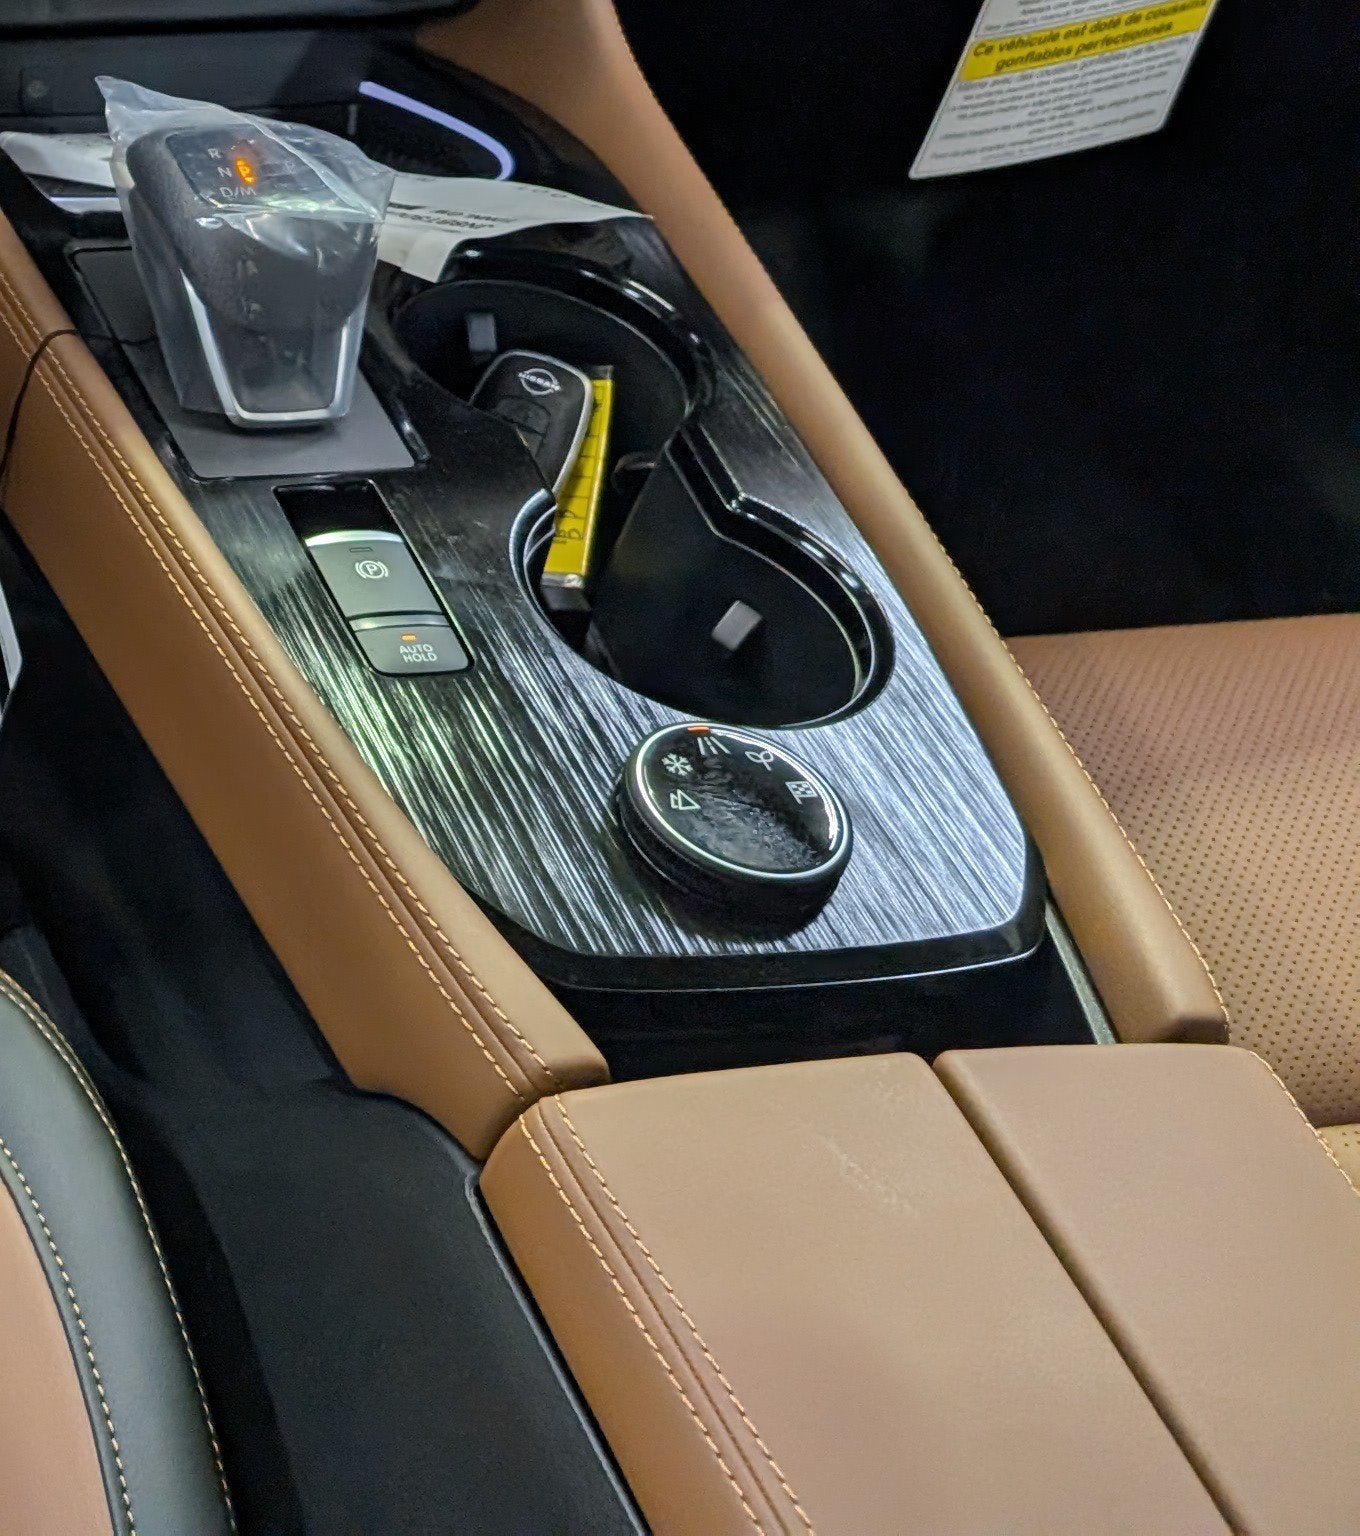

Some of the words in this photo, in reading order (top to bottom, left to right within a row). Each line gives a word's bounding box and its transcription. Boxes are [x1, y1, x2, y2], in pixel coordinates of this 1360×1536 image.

[972, 42, 994, 58] Ce
[207, 147, 222, 160] R
[217, 166, 233, 178] N
[219, 186, 257, 200] D/M
[399, 643, 434, 654] AUTO
[402, 652, 438, 663] HOLD
